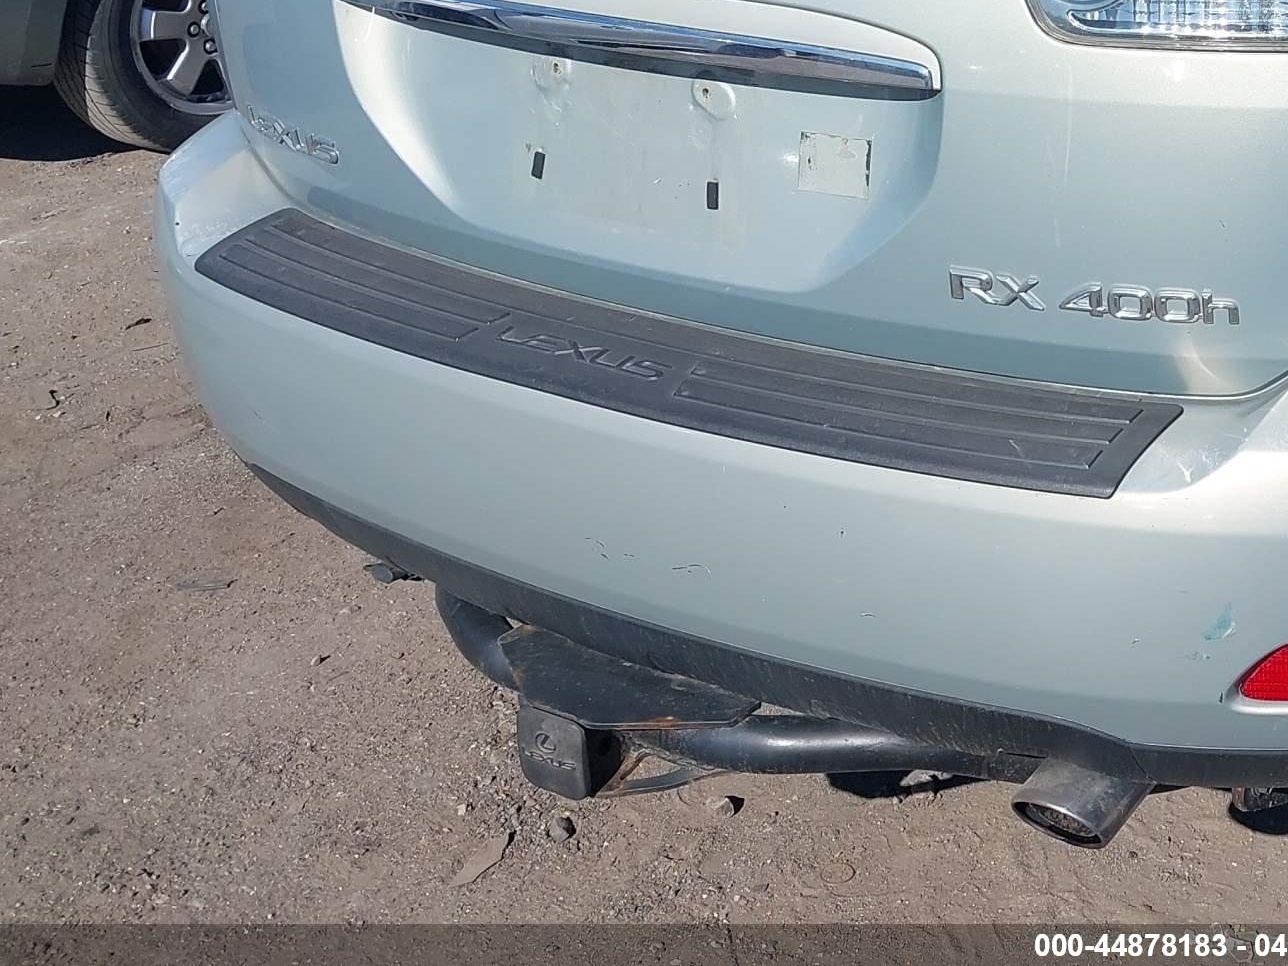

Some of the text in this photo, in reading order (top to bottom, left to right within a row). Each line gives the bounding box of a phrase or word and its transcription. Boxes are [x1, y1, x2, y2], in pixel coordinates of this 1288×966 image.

[247, 104, 340, 165] LEXUS
[948, 263, 1240, 326] RX 400h
[496, 325, 673, 381] LEXUS
